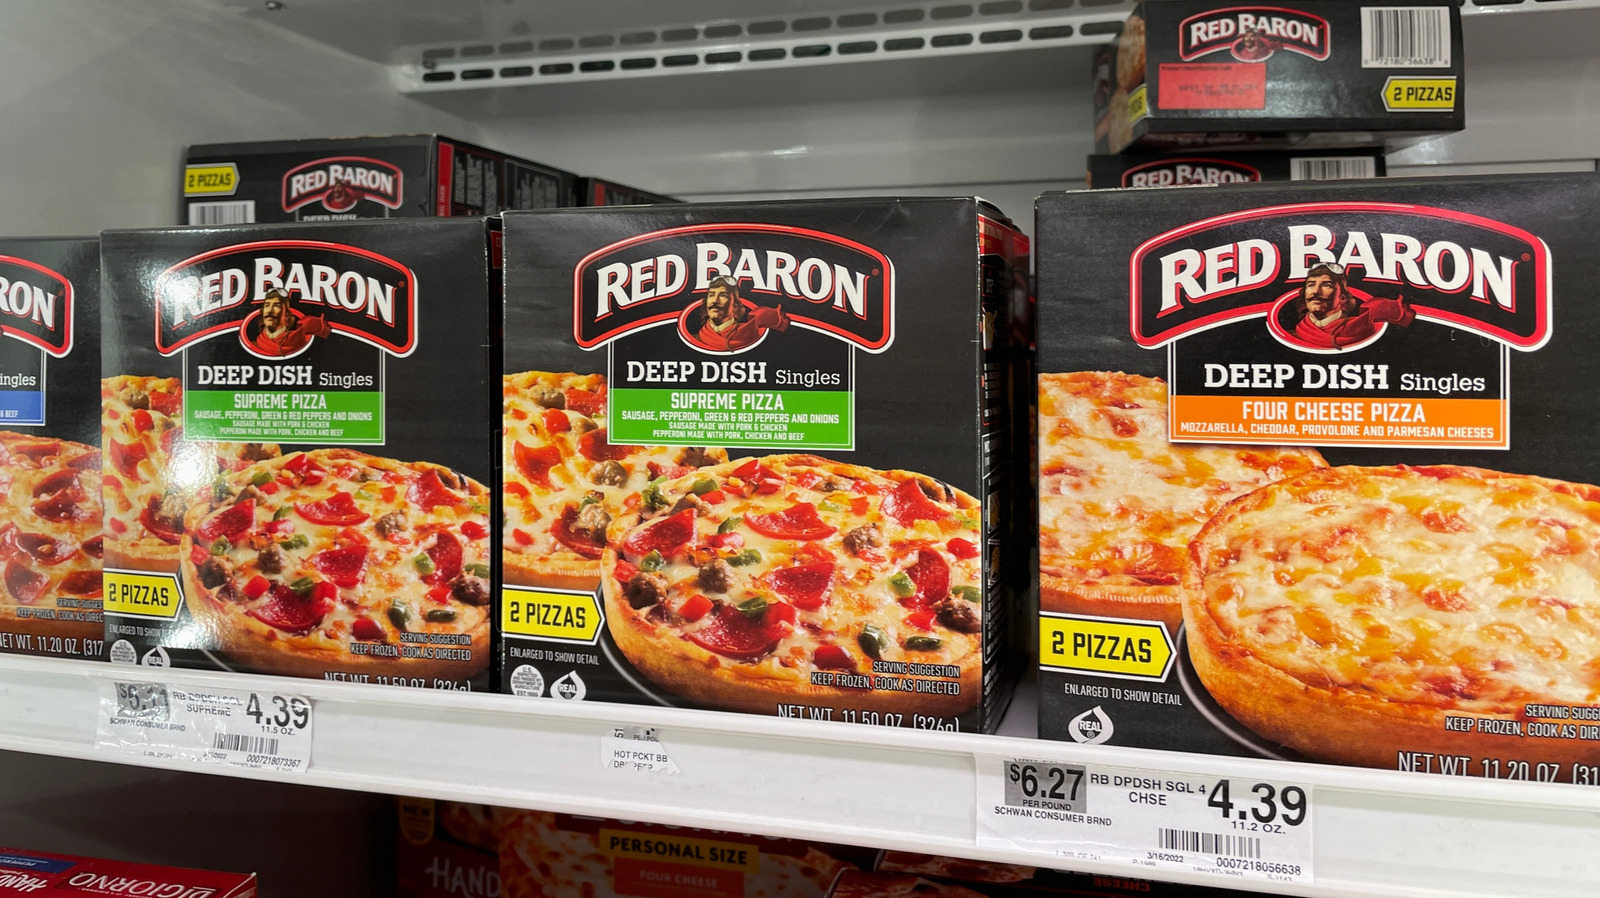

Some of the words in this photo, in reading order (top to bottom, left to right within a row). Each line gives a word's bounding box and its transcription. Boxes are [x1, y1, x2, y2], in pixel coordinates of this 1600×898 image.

[1190, 19, 1238, 48] RED
[1238, 14, 1320, 48] BARON
[1394, 87, 1402, 101] 2
[1407, 87, 1452, 101] PIZZAS
[188, 174, 195, 187] 2
[198, 173, 232, 186] PIZZAS
[291, 170, 326, 199] RED
[329, 164, 393, 195] BARON
[1132, 169, 1174, 187] RED
[1176, 165, 1249, 184] BARON
[1159, 238, 1277, 312] RED
[1287, 224, 1514, 308] BARON
[596, 254, 686, 317] RED
[695, 242, 866, 317] BARON
[169, 268, 248, 326] RED
[252, 257, 395, 327] BARON
[197, 365, 254, 385] DEEP
[258, 366, 313, 385] DISH
[319, 372, 373, 388] Singles
[627, 361, 696, 382] DEEP
[701, 362, 767, 383] DISH
[775, 369, 840, 387] Singles
[1204, 364, 1295, 388] DEEP
[1302, 364, 1389, 390] DISH
[1400, 374, 1485, 395] Singles
[234, 394, 288, 409] SUPREME
[292, 394, 327, 409] PIZZA
[671, 393, 737, 410] SUPREME
[742, 394, 784, 410] PIZZA
[194, 411, 224, 420] SAUSAGE,
[225, 411, 260, 421] PEPPERONI,
[261, 412, 281, 420] GREEN
[289, 412, 301, 420] RED
[303, 412, 331, 421] PEPPERS
[333, 412, 346, 421] AND
[348, 412, 372, 421] ONIONS
[622, 411, 658, 421] SAUSAGE,
[660, 412, 702, 422] PEPPERONI,
[704, 413, 729, 422] GREEN
[738, 413, 753, 422] RED
[755, 414, 790, 423] PEPPERS
[791, 414, 807, 423] AND
[810, 414, 839, 424] ONIONS
[1242, 401, 1288, 421] FOUR
[1294, 402, 1364, 422] CHEESE
[1371, 402, 1426, 423] PIZZA
[653, 430, 686, 438] PEPPERONI
[687, 431, 706, 439] MADE
[707, 431, 723, 439] WITH
[724, 432, 743, 440] PORK,
[745, 432, 772, 440] CHICKEN
[788, 433, 804, 441] BEEF
[669, 422, 697, 430] SAUSAGE
[699, 422, 717, 431] MADE
[718, 423, 735, 431] WITH
[736, 423, 753, 431] PORK
[760, 424, 787, 432] CHICKEN
[1180, 422, 1249, 435] MOZZARELLA,
[1250, 423, 1299, 436] CHEDDAR,
[1301, 424, 1362, 436] PROVOLONE
[1364, 425, 1385, 437] AND
[1387, 425, 1445, 438] PARMESAN
[1447, 426, 1494, 439] CHEESES
[57, 598, 79, 608] SERVING
[109, 582, 117, 601] 2
[121, 584, 169, 606] PIZZAS
[17, 607, 32, 618] KEEP
[33, 609, 57, 620] FROZEN,
[58, 611, 74, 621] COOK
[76, 612, 84, 621] AS
[510, 601, 520, 622] 2
[526, 602, 586, 628] PIZZAS
[109, 624, 136, 635] ENLARGED
[137, 626, 144, 636] TO
[145, 627, 162, 637] SHOW
[400, 632, 428, 643] SERVING
[430, 634, 471, 645] SUGGESTION
[16, 634, 35, 651] WT.
[37, 636, 62, 653] 11.20
[65, 638, 81, 655] OZ.
[351, 643, 369, 654] KEEP
[371, 644, 400, 658] FROZEN,
[401, 647, 422, 658] COOK
[423, 648, 433, 658] AS
[435, 649, 471, 661] DIRECTED
[1052, 631, 1064, 654] 2
[1073, 632, 1151, 663] PIZZAS
[510, 647, 544, 660] ENLARGED
[545, 650, 553, 661] TO
[555, 651, 575, 663] SHOW
[577, 652, 599, 665] DETAIL
[873, 661, 908, 674] SERVING
[909, 664, 960, 678] SUGGESTION
[560, 684, 578, 693] REAL
[811, 672, 834, 685] KEEP
[837, 674, 873, 690] FROZEN,
[875, 678, 901, 691] COOK
[901, 680, 913, 692] AS
[916, 680, 960, 695] DIRECTED
[1065, 683, 1108, 698] ENLARGED
[1110, 687, 1121, 699] TO
[1124, 689, 1150, 702] SHOW
[1152, 693, 1182, 706] DETAIL
[187, 704, 231, 716] SUPREME
[246, 693, 309, 729] 4.39
[1525, 704, 1569, 719] SERVING
[1571, 708, 1600, 721] SUGG
[262, 726, 278, 734] 11.5
[281, 727, 295, 736] OZ.
[1078, 720, 1101, 732] REAL
[1446, 716, 1474, 732] KEEP
[1477, 719, 1524, 737] FROZEN,
[1527, 722, 1558, 738] COOK
[1561, 725, 1576, 739] AS
[614, 750, 630, 758] HOT
[633, 752, 654, 761] PCKT
[1398, 751, 1434, 774] NET
[1009, 763, 1084, 801] $6.27
[1090, 774, 1110, 785] RB
[1114, 776, 1162, 791] DPDSH
[1165, 781, 1194, 794] SGL
[1023, 799, 1040, 808] PER
[1042, 801, 1072, 811] POUND
[1129, 793, 1167, 806] CHSE
[1207, 779, 1307, 826] 4.39
[994, 806, 1033, 818] SCHWAN
[1034, 811, 1085, 824] CONSUMER
[1087, 816, 1112, 827] BRND
[1232, 821, 1258, 832] 11.2
[1262, 824, 1286, 835] OZ.
[609, 835, 704, 861] PERSONAL
[709, 847, 747, 865] SIZE
[1147, 852, 1184, 864] 3/16/2022
[1216, 857, 1301, 876] 0007218056638
[425, 856, 500, 898] HAND
[639, 870, 672, 884] FOUR
[675, 874, 718, 889] CHEESE
